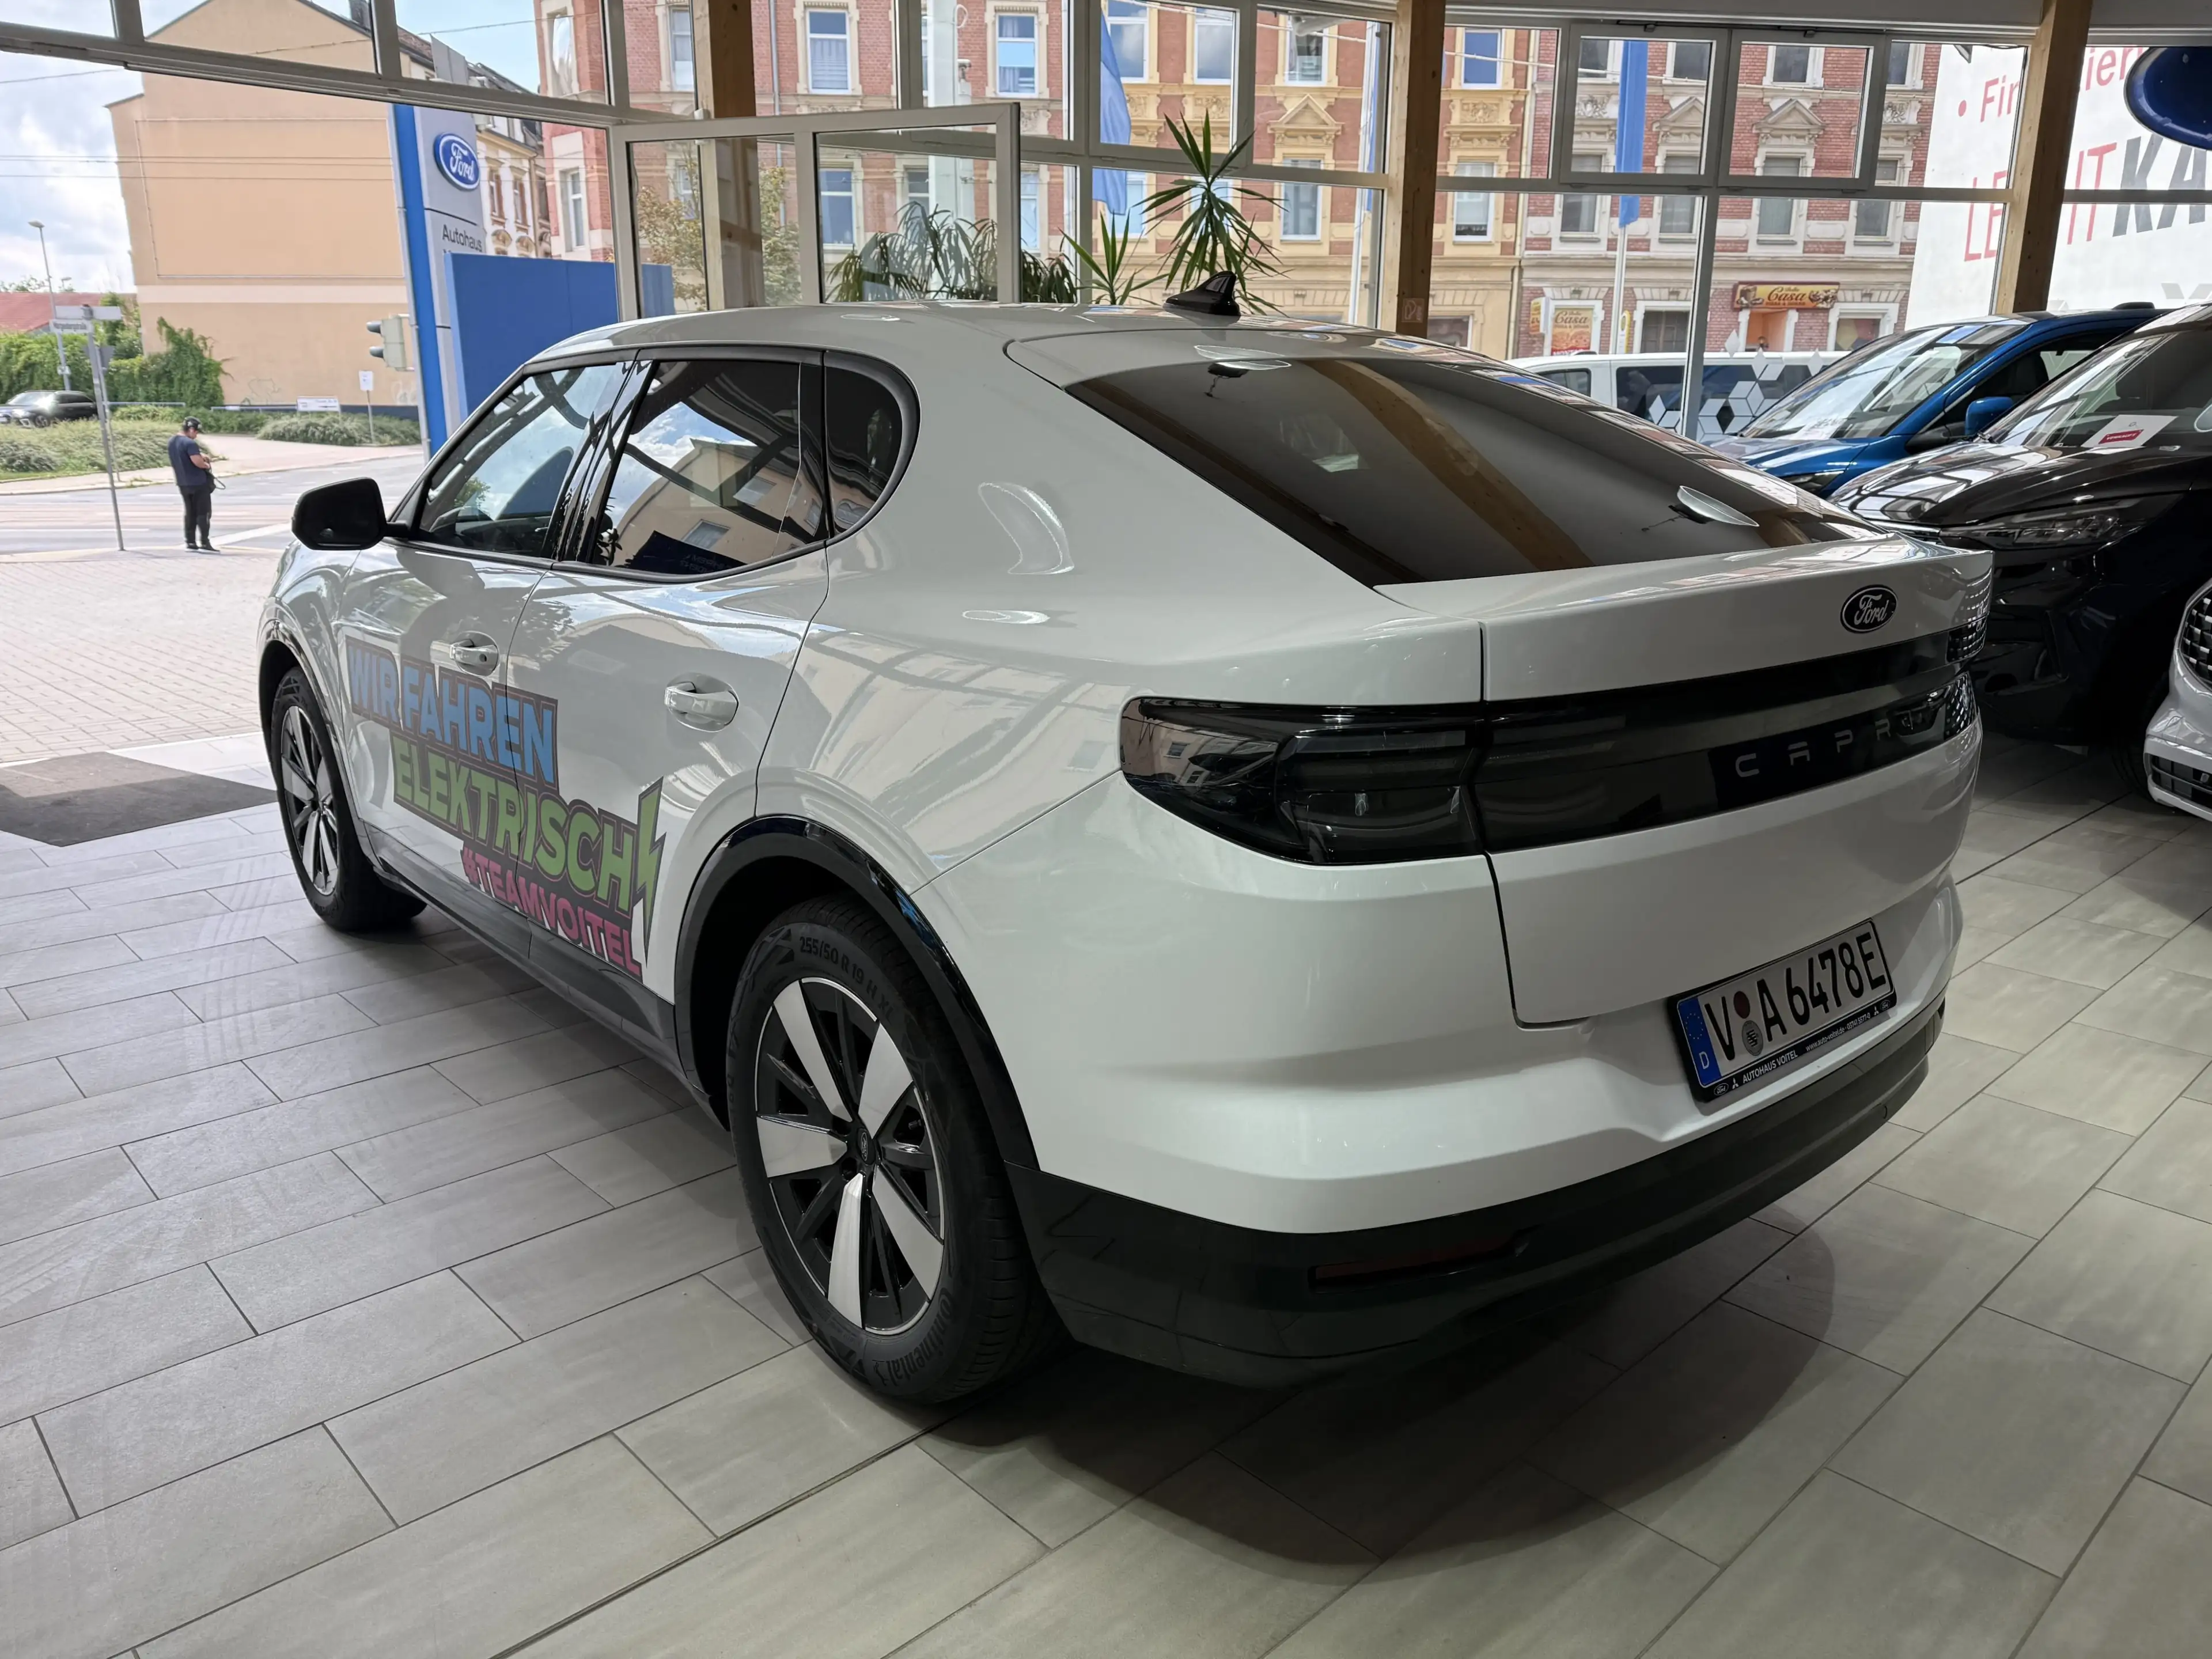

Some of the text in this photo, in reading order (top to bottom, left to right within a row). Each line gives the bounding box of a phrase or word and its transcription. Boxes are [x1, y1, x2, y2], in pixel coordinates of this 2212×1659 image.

[449, 142, 476, 182] Ford
[442, 224, 483, 252] Autohaus
[1555, 310, 1589, 324] Casa
[1767, 286, 1806, 301] Casa
[1854, 594, 1888, 625] Ford
[348, 646, 555, 784] WIR FAHREN
[392, 735, 634, 912] ELEKTRISCH
[461, 846, 642, 976] #TEAMVOITEL
[800, 936, 839, 965] 255/50
[841, 954, 850, 974] R
[852, 963, 865, 984] 19
[866, 979, 877, 999] H
[1704, 996, 1736, 1060] V
[1756, 978, 1787, 1042] A
[1785, 931, 1887, 1026] 6478E
[1698, 1051, 1710, 1070] D
[1743, 1060, 1777, 1084] AUTOHAUS
[1776, 1050, 1798, 1066] VOITEL
[1805, 1027, 1845, 1052] www.auto-voitel.de
[886, 1287, 954, 1387] Continental
